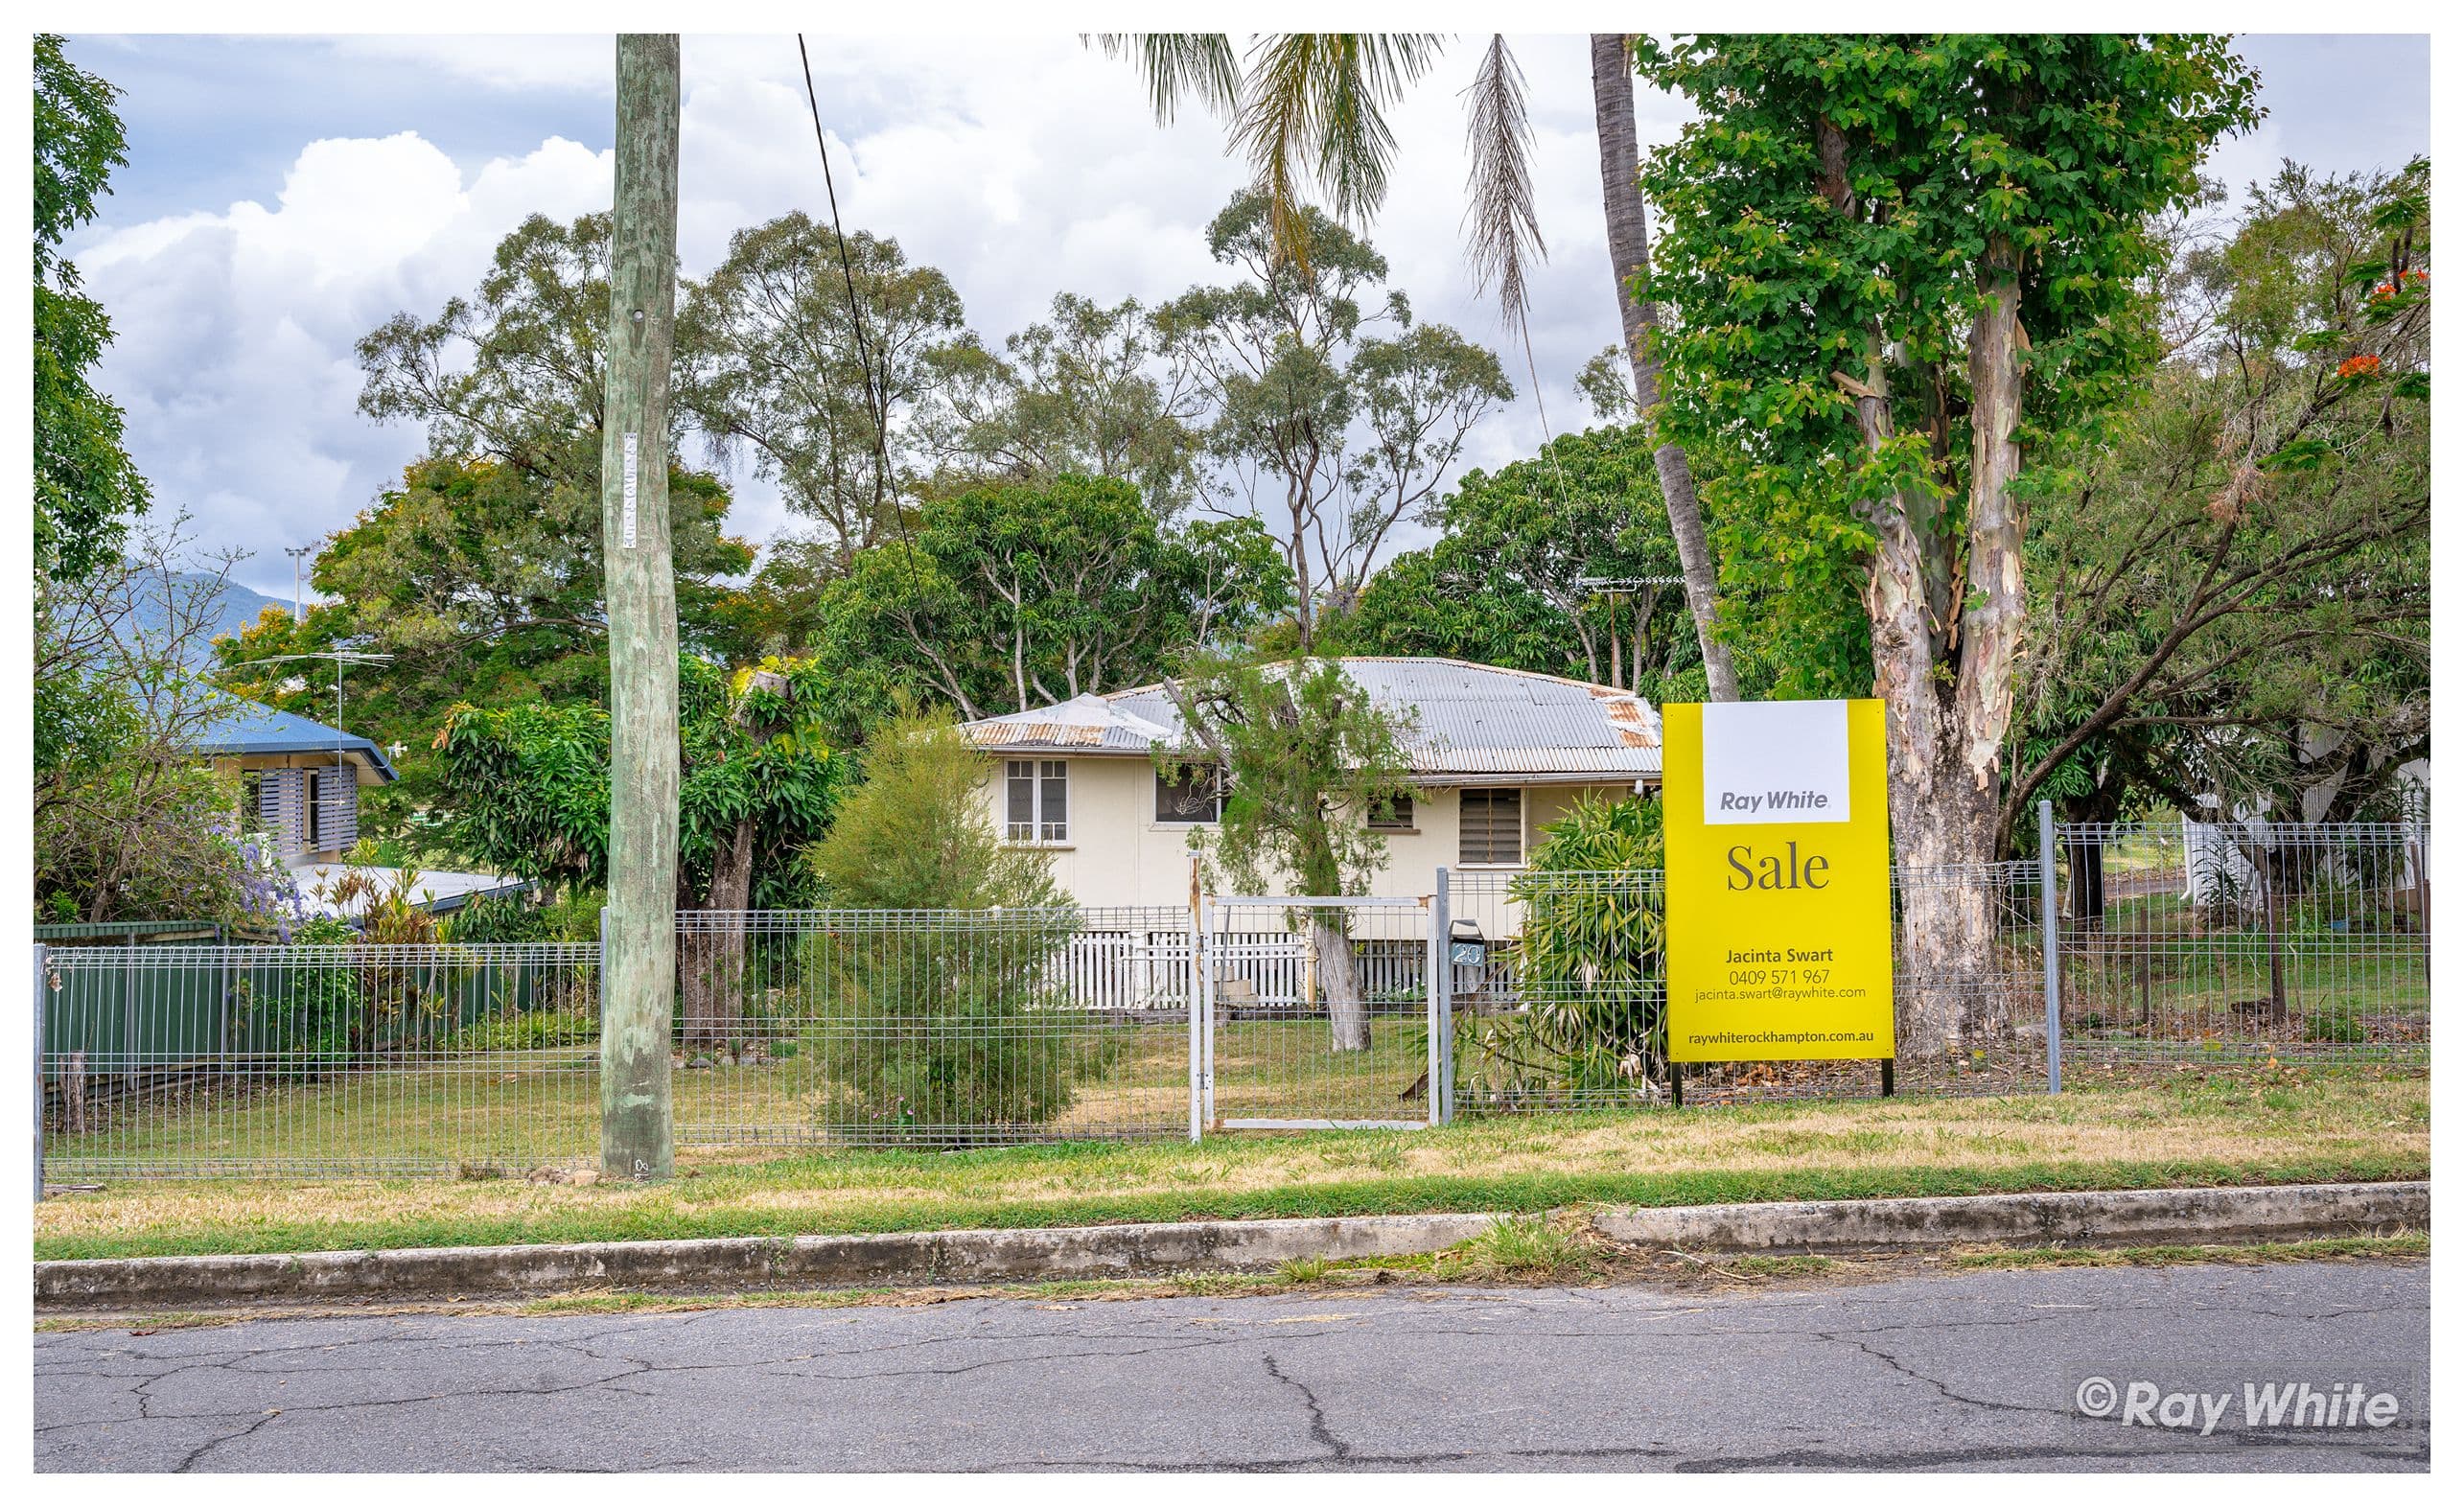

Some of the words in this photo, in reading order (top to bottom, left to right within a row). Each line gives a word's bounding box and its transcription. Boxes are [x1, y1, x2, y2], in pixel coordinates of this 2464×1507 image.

[1720, 791, 1764, 814] Ray
[1767, 790, 1828, 809] White
[1727, 842, 1829, 891] Sale
[1453, 944, 1481, 964] 20
[1726, 948, 1781, 963] Jacinta
[1786, 948, 1834, 962] Swart
[1729, 969, 1767, 985] 0409
[1771, 969, 1797, 985] 571
[1802, 968, 1830, 984] 967
[1695, 986, 1866, 1004] jacinta.swart@raywhite.com
[1688, 1031, 1873, 1046] raywhiterockhampton.com.au
